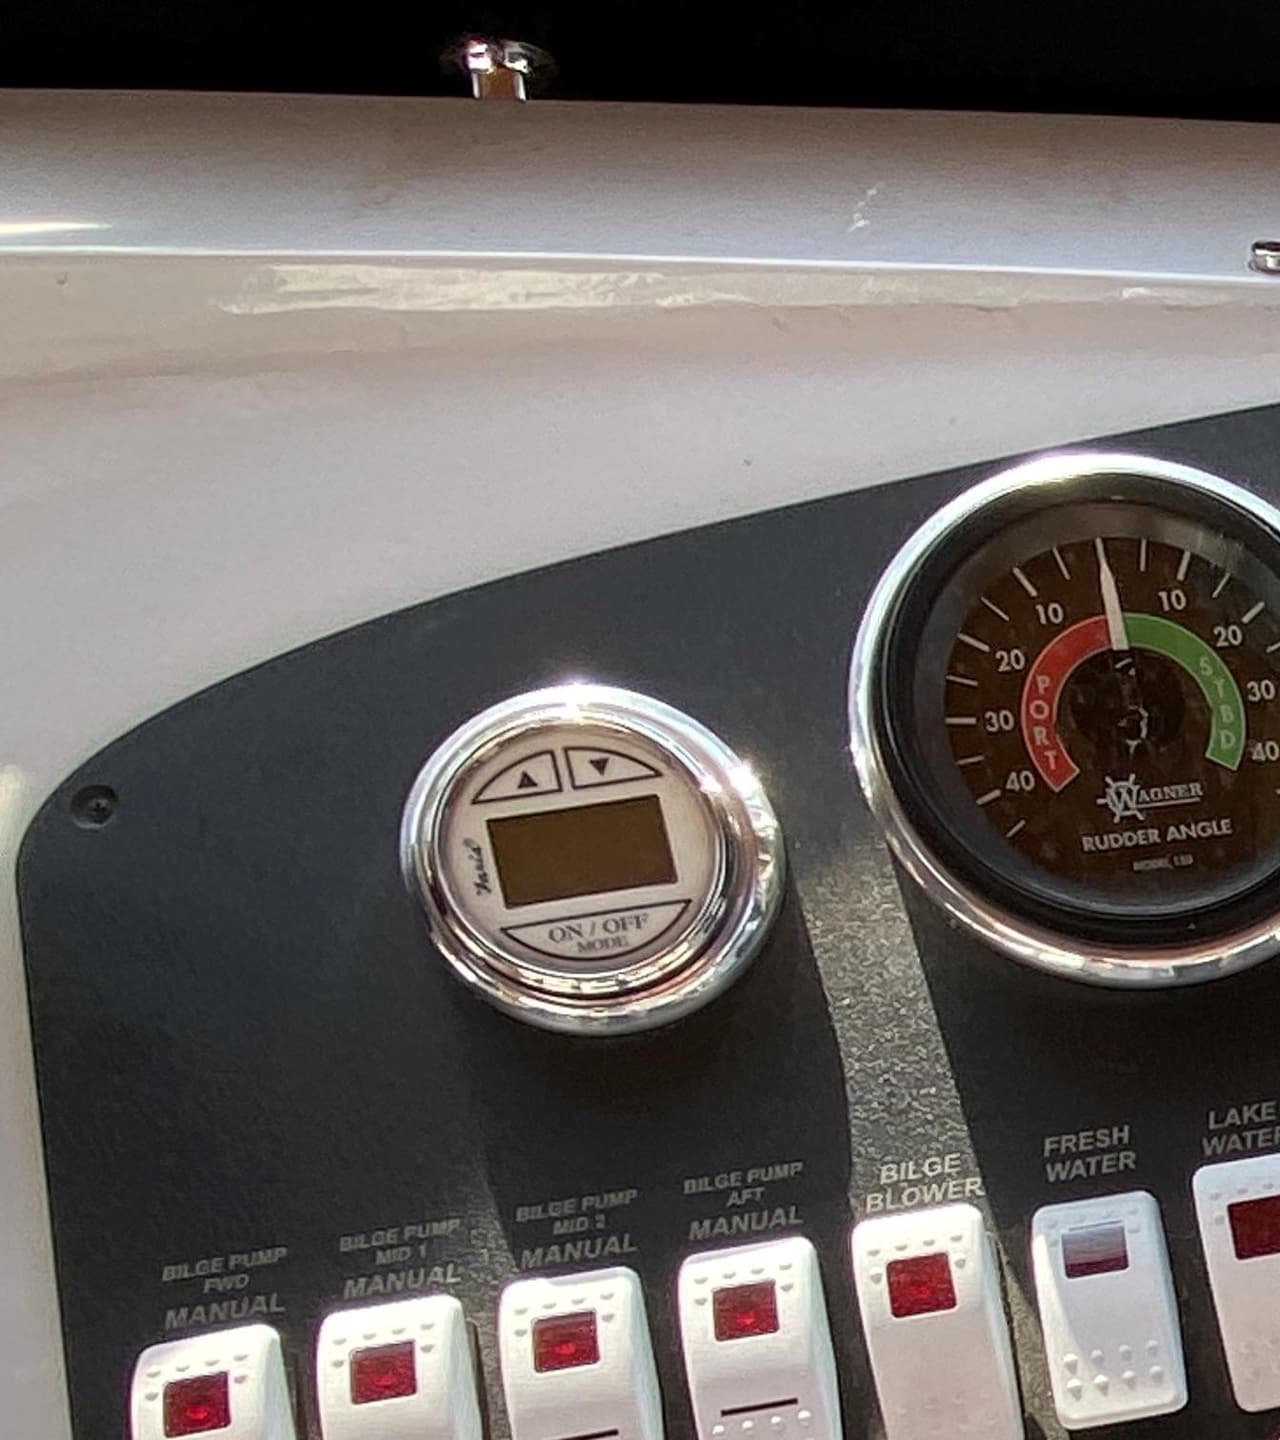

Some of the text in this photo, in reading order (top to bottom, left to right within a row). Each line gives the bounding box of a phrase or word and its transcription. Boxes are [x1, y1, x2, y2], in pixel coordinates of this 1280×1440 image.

[1036, 602, 1064, 625] 10
[1158, 588, 1187, 613] 10
[1213, 624, 1243, 648] 20
[996, 649, 1026, 672] 20
[1246, 679, 1276, 702] 30
[984, 709, 1014, 732] 30
[1028, 674, 1059, 771] PORT
[1251, 741, 1280, 763] 40
[1006, 770, 1035, 792] 40
[1081, 817, 1233, 854] RUDDER ANGLE
[548, 923, 583, 944] ON
[602, 913, 649, 936] OFF
[577, 935, 629, 954] MODE
[1208, 1101, 1277, 1130] LAKE
[1044, 1125, 1131, 1157] FRESH
[683, 1161, 803, 1194] BILGE PUMP
[879, 1153, 961, 1184] BILGE
[1046, 1150, 1136, 1182] WATER
[516, 1189, 638, 1222] BILGE PUMP
[726, 1186, 765, 1207] AFT
[866, 1176, 985, 1213] BLOWER
[339, 1218, 461, 1251] BILGE PUMP
[553, 1216, 589, 1235] MID
[688, 1205, 804, 1241] MANUAL
[162, 1247, 287, 1281] BILGE PUMP
[375, 1246, 412, 1265] MID
[520, 1233, 639, 1270] MANUAL
[203, 1273, 249, 1294] FWD
[343, 1262, 462, 1300] MANUAL
[165, 1292, 286, 1330] MANUAL
